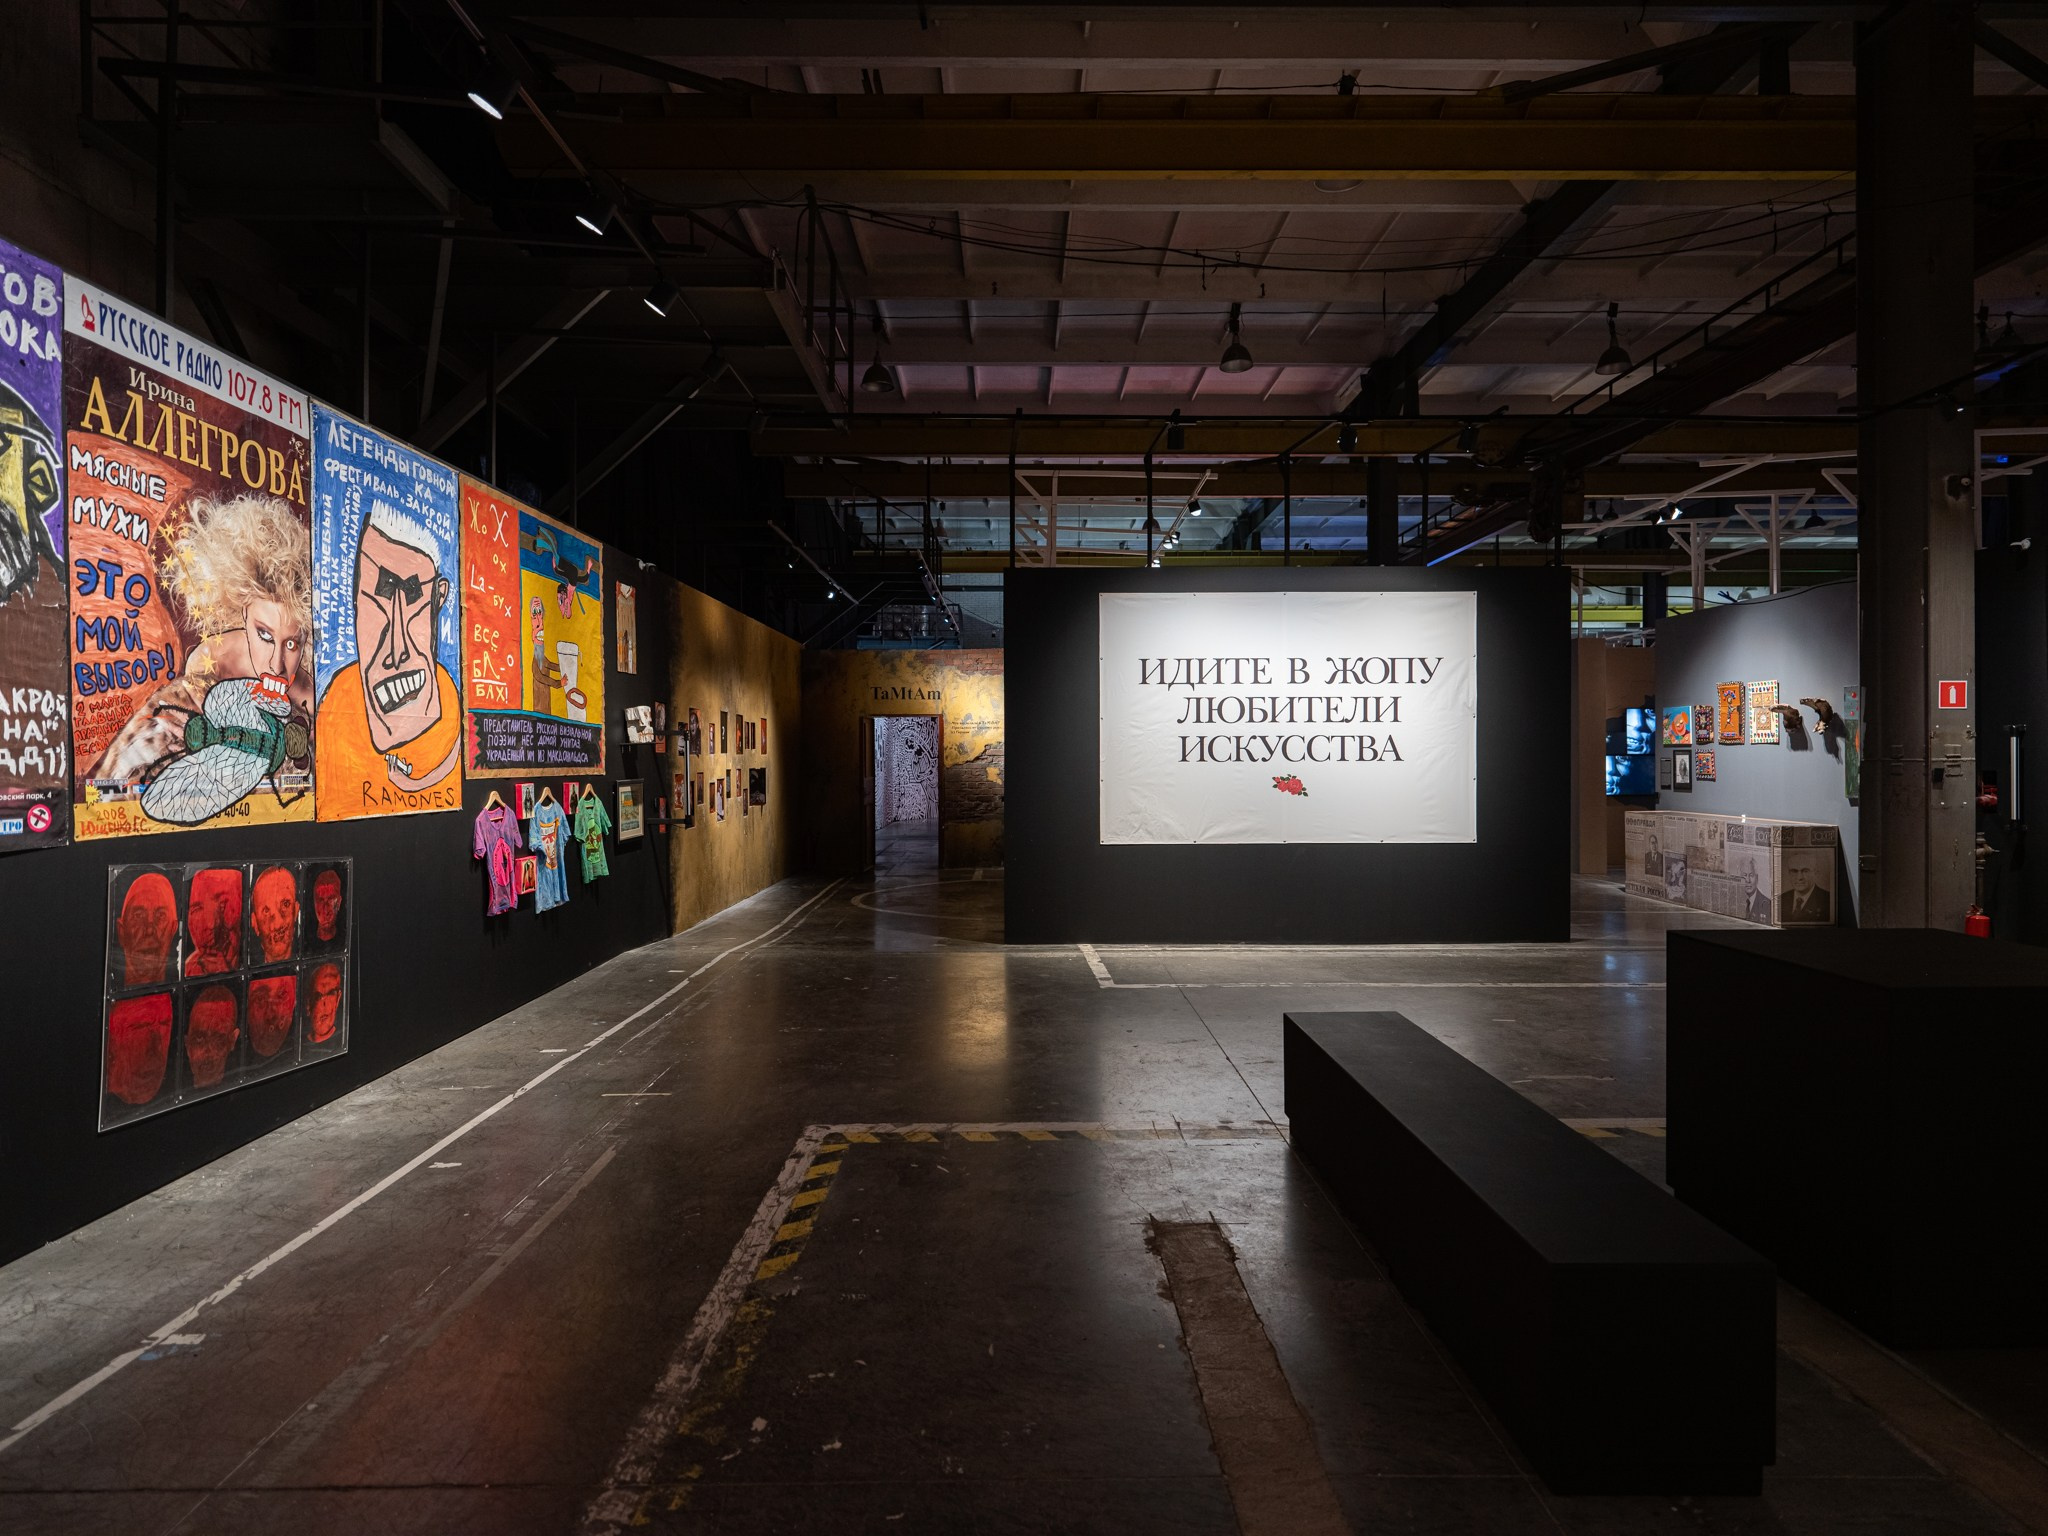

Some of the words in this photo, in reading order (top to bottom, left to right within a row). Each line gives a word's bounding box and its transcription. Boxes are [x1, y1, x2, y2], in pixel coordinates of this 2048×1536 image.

[0, 264, 62, 317] ОВ-
[98, 301, 171, 367] РУССКОЕ
[176, 339, 222, 390] РАДИО
[228, 368, 273, 414] 107.8
[278, 390, 303, 429] FM
[128, 366, 197, 413] Ирина
[80, 376, 306, 506] АЛЛЕГРОВА
[328, 419, 410, 477] ЛЕГЕНДЫ
[70, 445, 167, 502] МЯСНЫЕ
[323, 458, 400, 499] ФЕСТИВАЛЬ
[414, 481, 433, 504] КА
[72, 496, 150, 545] МУХИ
[75, 558, 150, 608] ЭТО
[320, 493, 333, 664] ГУТТАПЕРЧЕВЫЙ
[330, 556, 340, 612] ПАНК
[75, 609, 143, 653] МОЙ
[335, 605, 346, 661] ГРУППА
[74, 643, 176, 697] ВЫБОР!
[1138, 657, 1273, 691] ИДИТЕ
[1286, 657, 1311, 685] В
[1325, 656, 1444, 685] ЖОПУ
[73, 703, 134, 727] ГЛАВНЫЙ
[76, 701, 86, 717] 2
[89, 693, 133, 713] МАРТА
[1176, 696, 1402, 724] ЛЮБИТЕЛИ
[74, 719, 126, 743] ПРАЗДНИК
[487, 734, 516, 747] ПОЭЗИИ
[1178, 734, 1404, 763] ИСКУССТВА
[47, 791, 52, 799] 4
[96, 806, 127, 821] 2008
[362, 781, 455, 808] RAMONES
